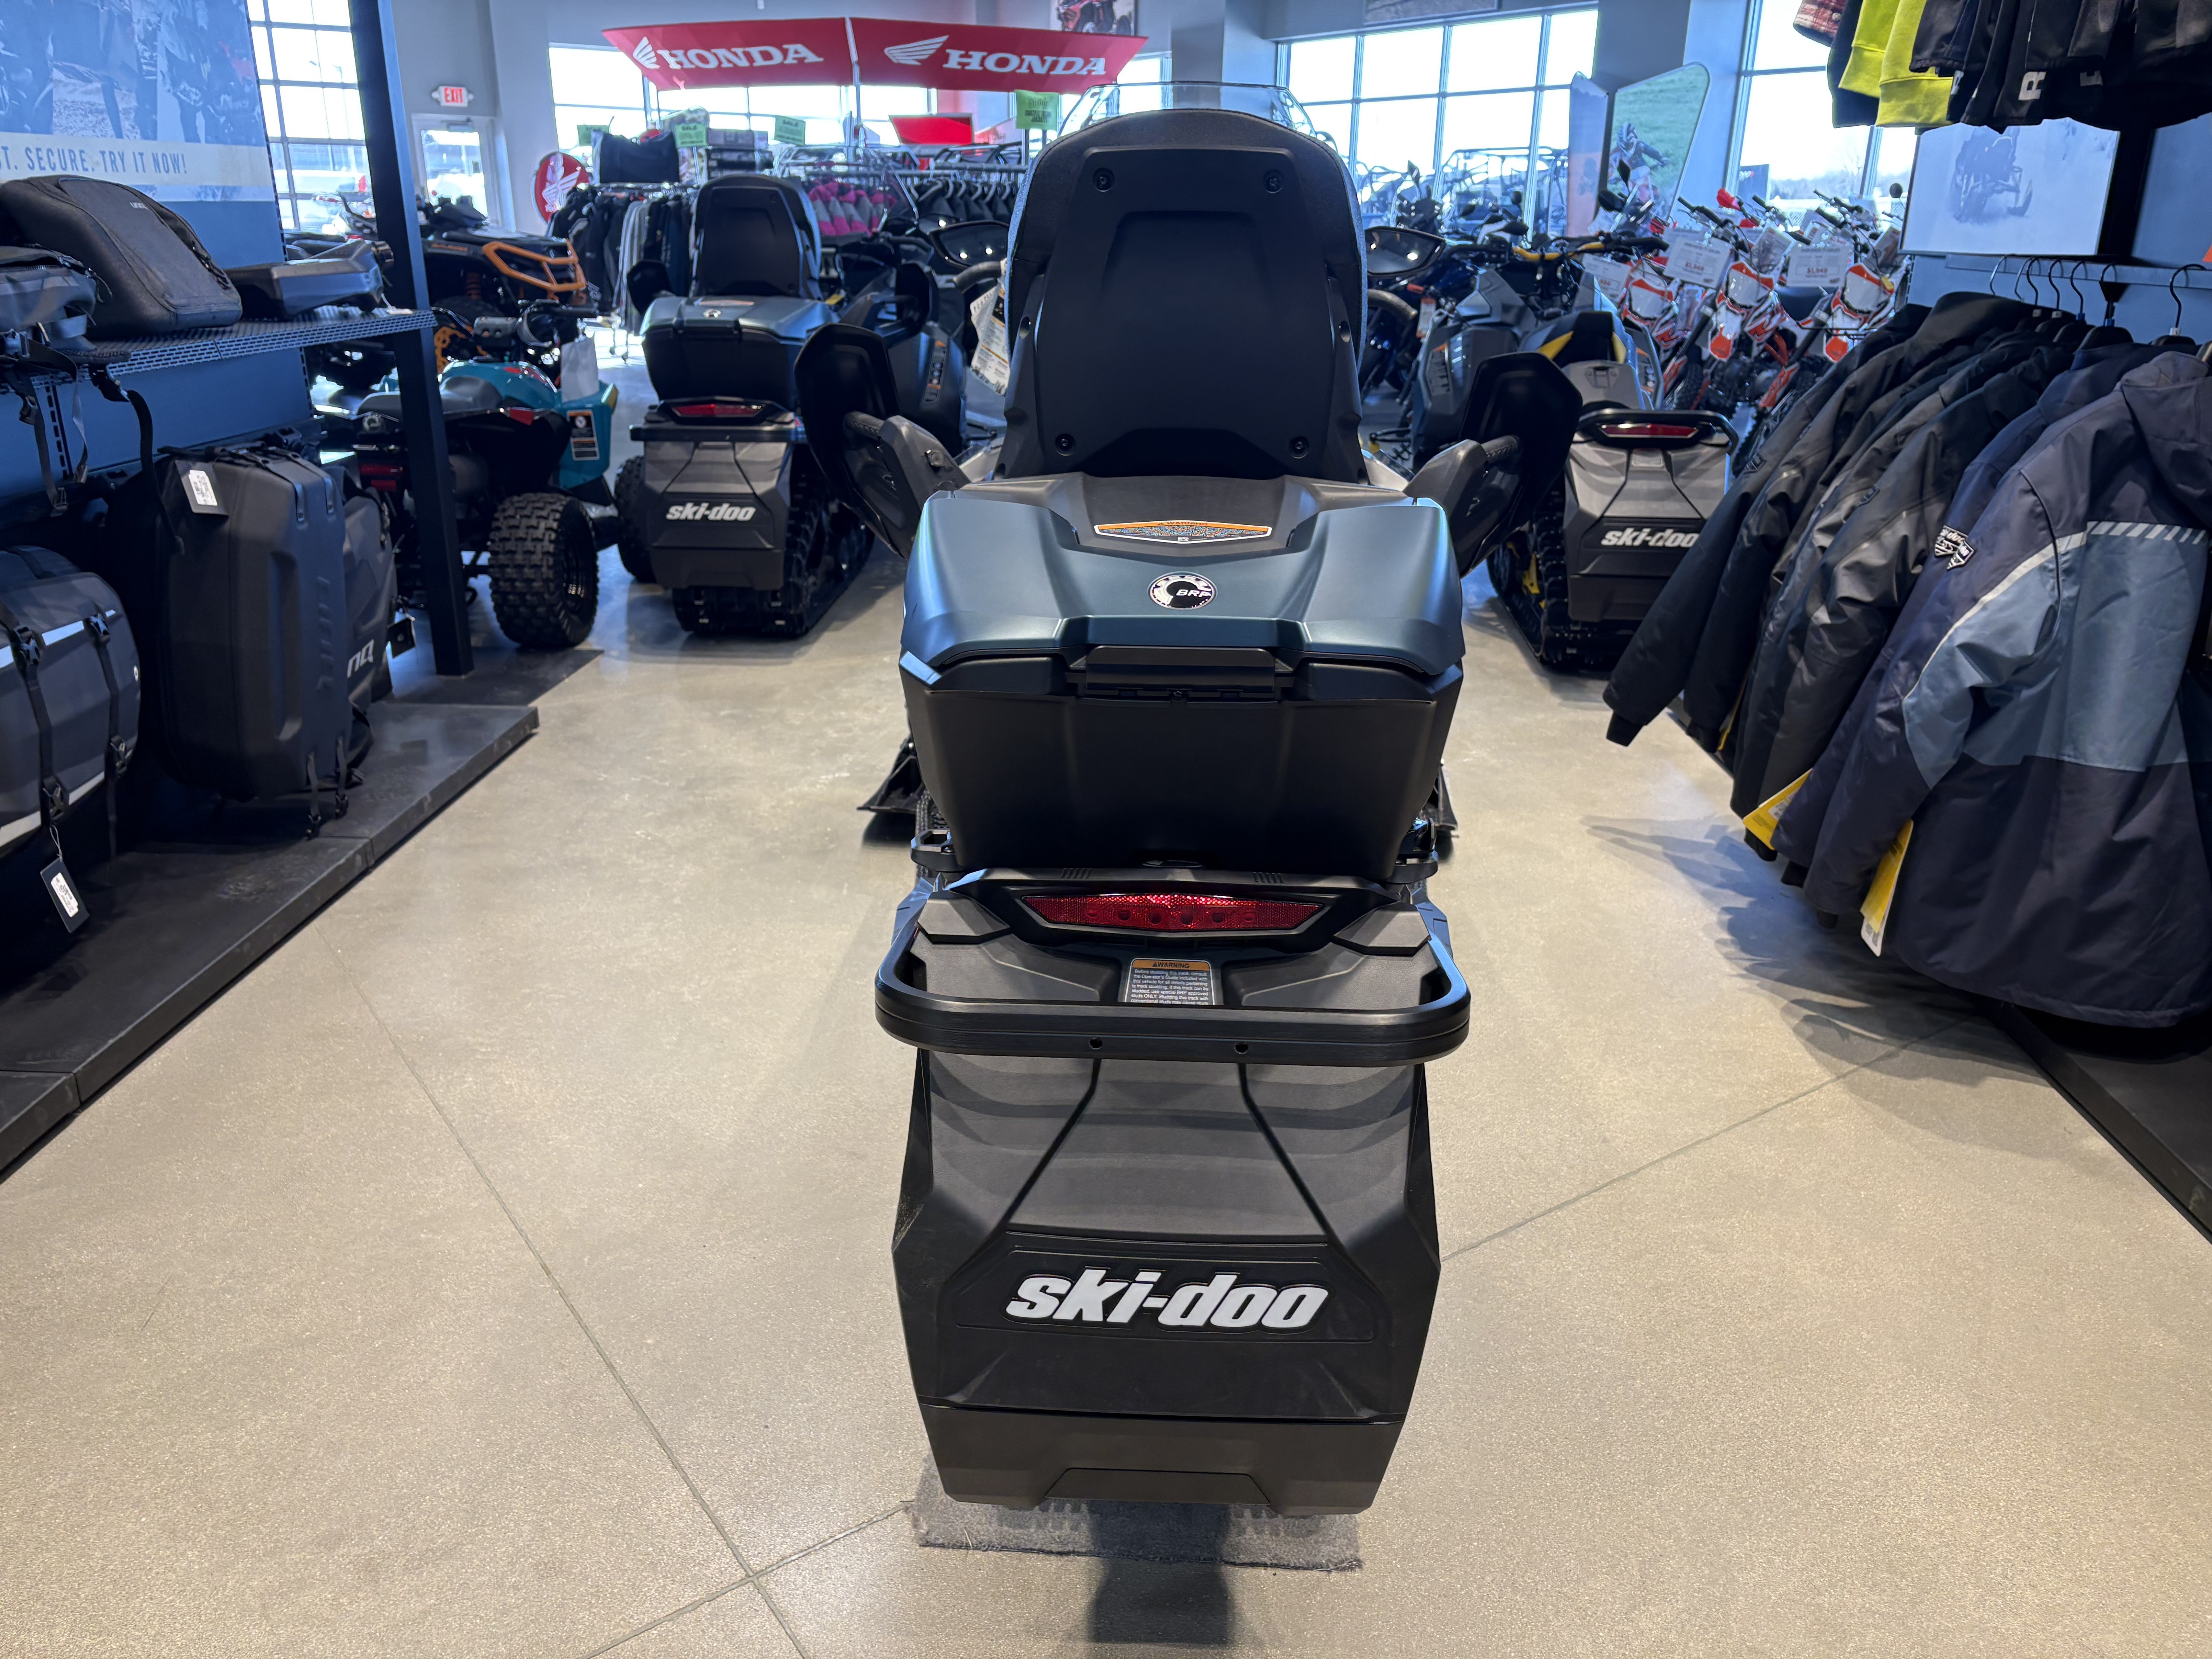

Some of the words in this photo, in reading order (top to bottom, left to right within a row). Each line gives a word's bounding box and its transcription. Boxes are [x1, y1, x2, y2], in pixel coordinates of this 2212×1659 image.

[657, 44, 824, 69] HONDA
[943, 49, 1106, 75] HONDA
[444, 87, 464, 104] EXIT
[0, 146, 19, 170] T.
[25, 146, 94, 172] SECURE.
[99, 150, 126, 173] TRY
[132, 151, 148, 173] IT
[153, 153, 188, 174] NOW!
[666, 502, 756, 521] ski-doo
[1601, 527, 1700, 548] ski-doo
[1176, 589, 1211, 598] BRP
[1006, 1269, 1329, 1328] ski-doo
